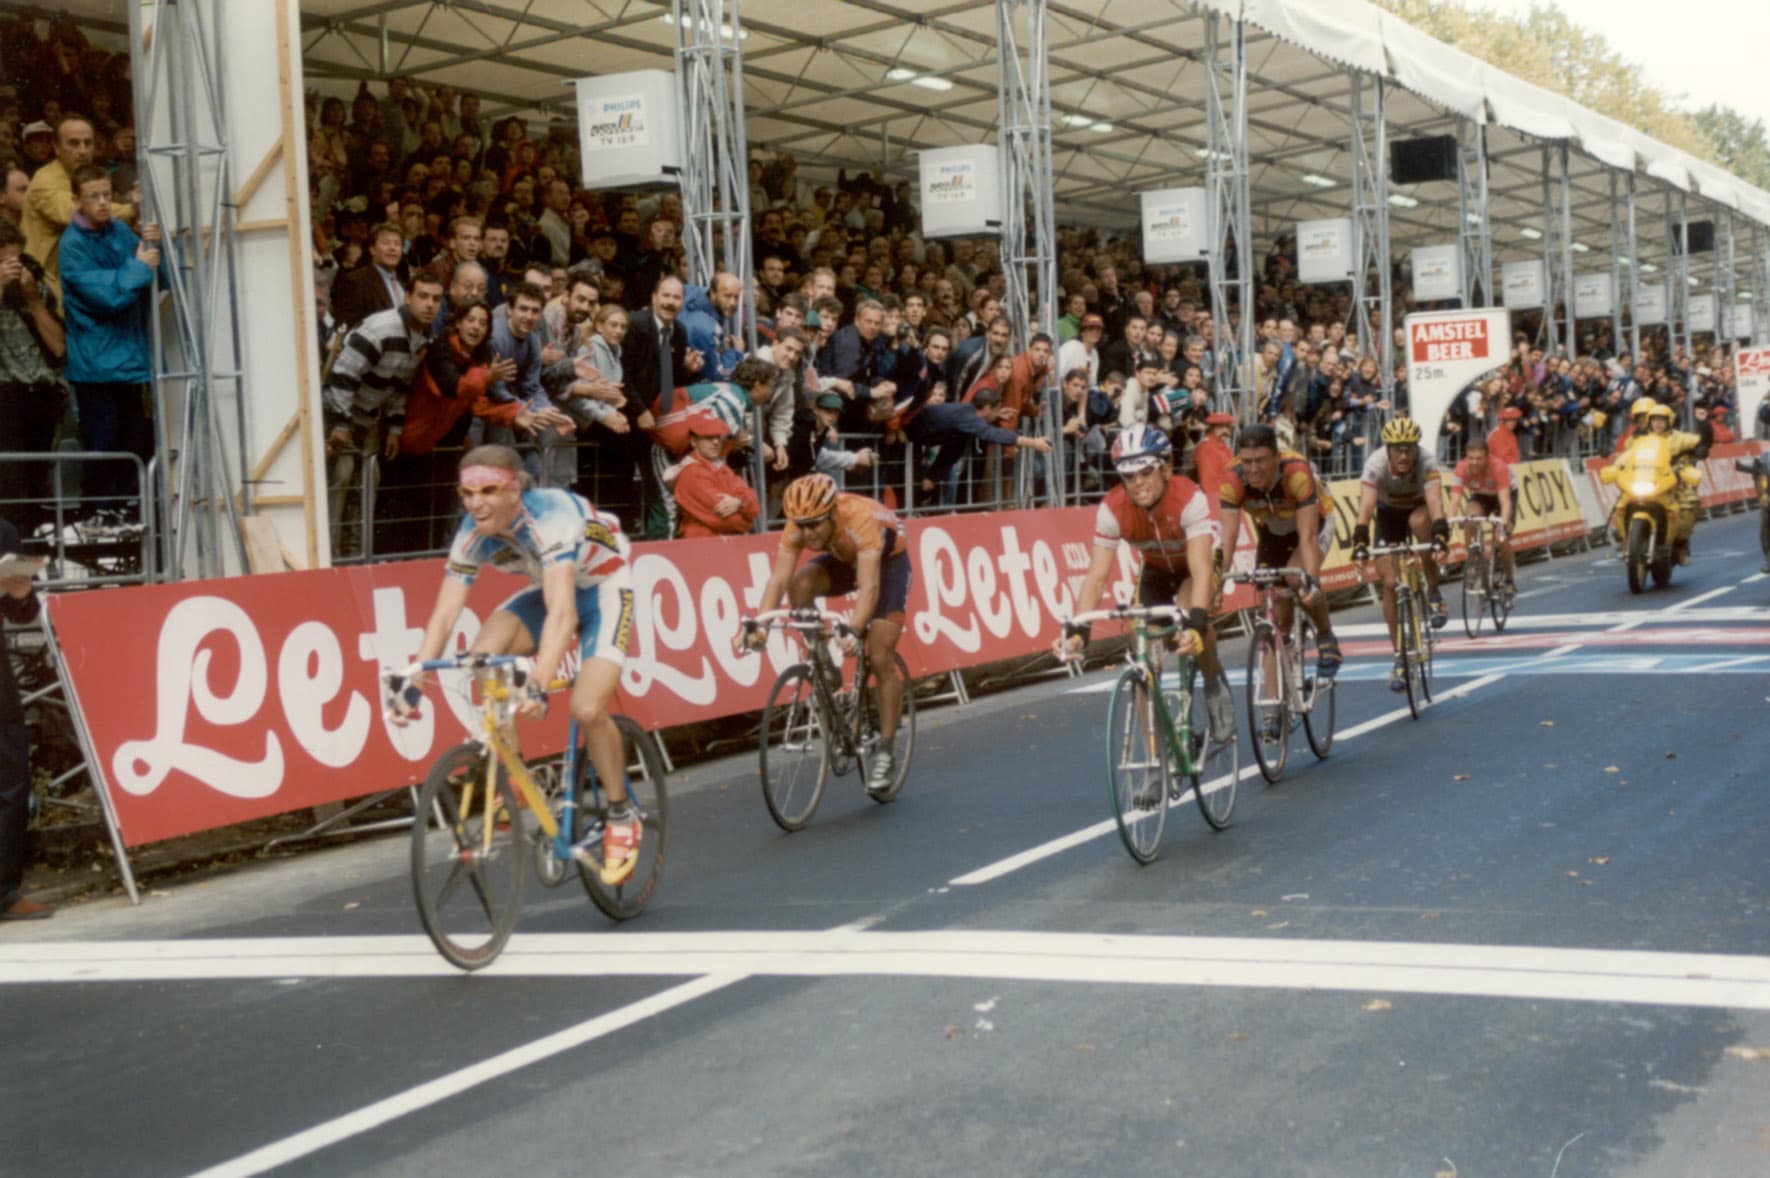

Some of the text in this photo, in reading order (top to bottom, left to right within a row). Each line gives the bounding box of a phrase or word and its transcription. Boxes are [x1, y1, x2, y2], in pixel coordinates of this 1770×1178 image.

[1416, 321, 1486, 342] AMSTEL
[1427, 341, 1475, 361] BEER
[913, 525, 1073, 654] Lete
[619, 552, 845, 706] Let
